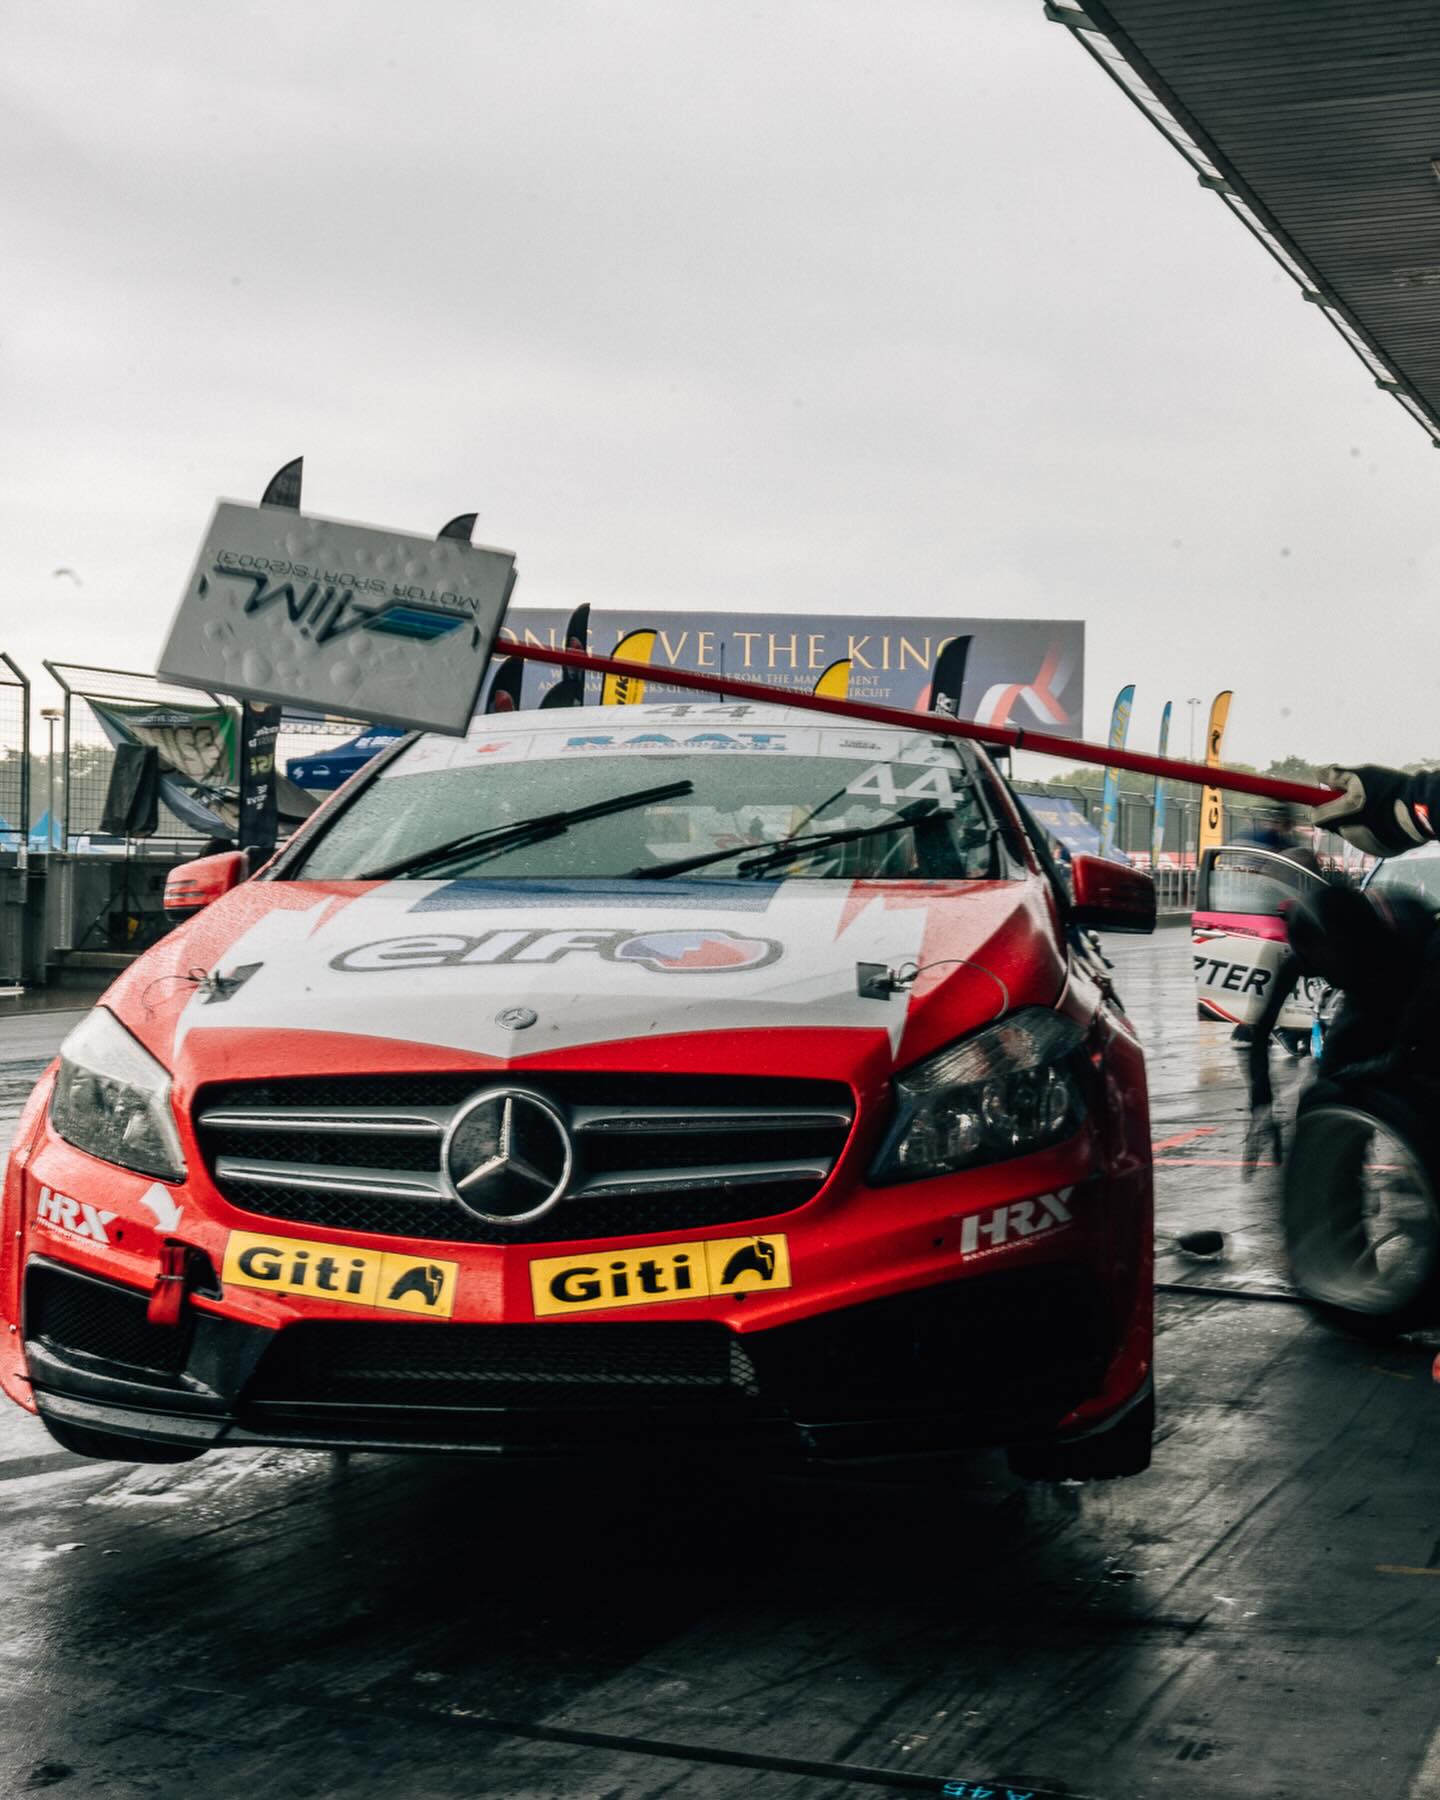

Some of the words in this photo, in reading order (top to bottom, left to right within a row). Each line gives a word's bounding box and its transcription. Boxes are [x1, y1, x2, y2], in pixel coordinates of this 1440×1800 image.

[391, 582, 480, 611] MOTOR
[732, 632, 825, 668] THE
[767, 673, 790, 684] THE
[849, 687, 893, 698] IRCUIT
[644, 705, 756, 718] 44
[846, 763, 965, 809] 44
[37, 1186, 119, 1243] HRX
[961, 1186, 1073, 1254] HRX
[238, 1247, 366, 1294] Giti
[549, 1253, 692, 1302] Giti
